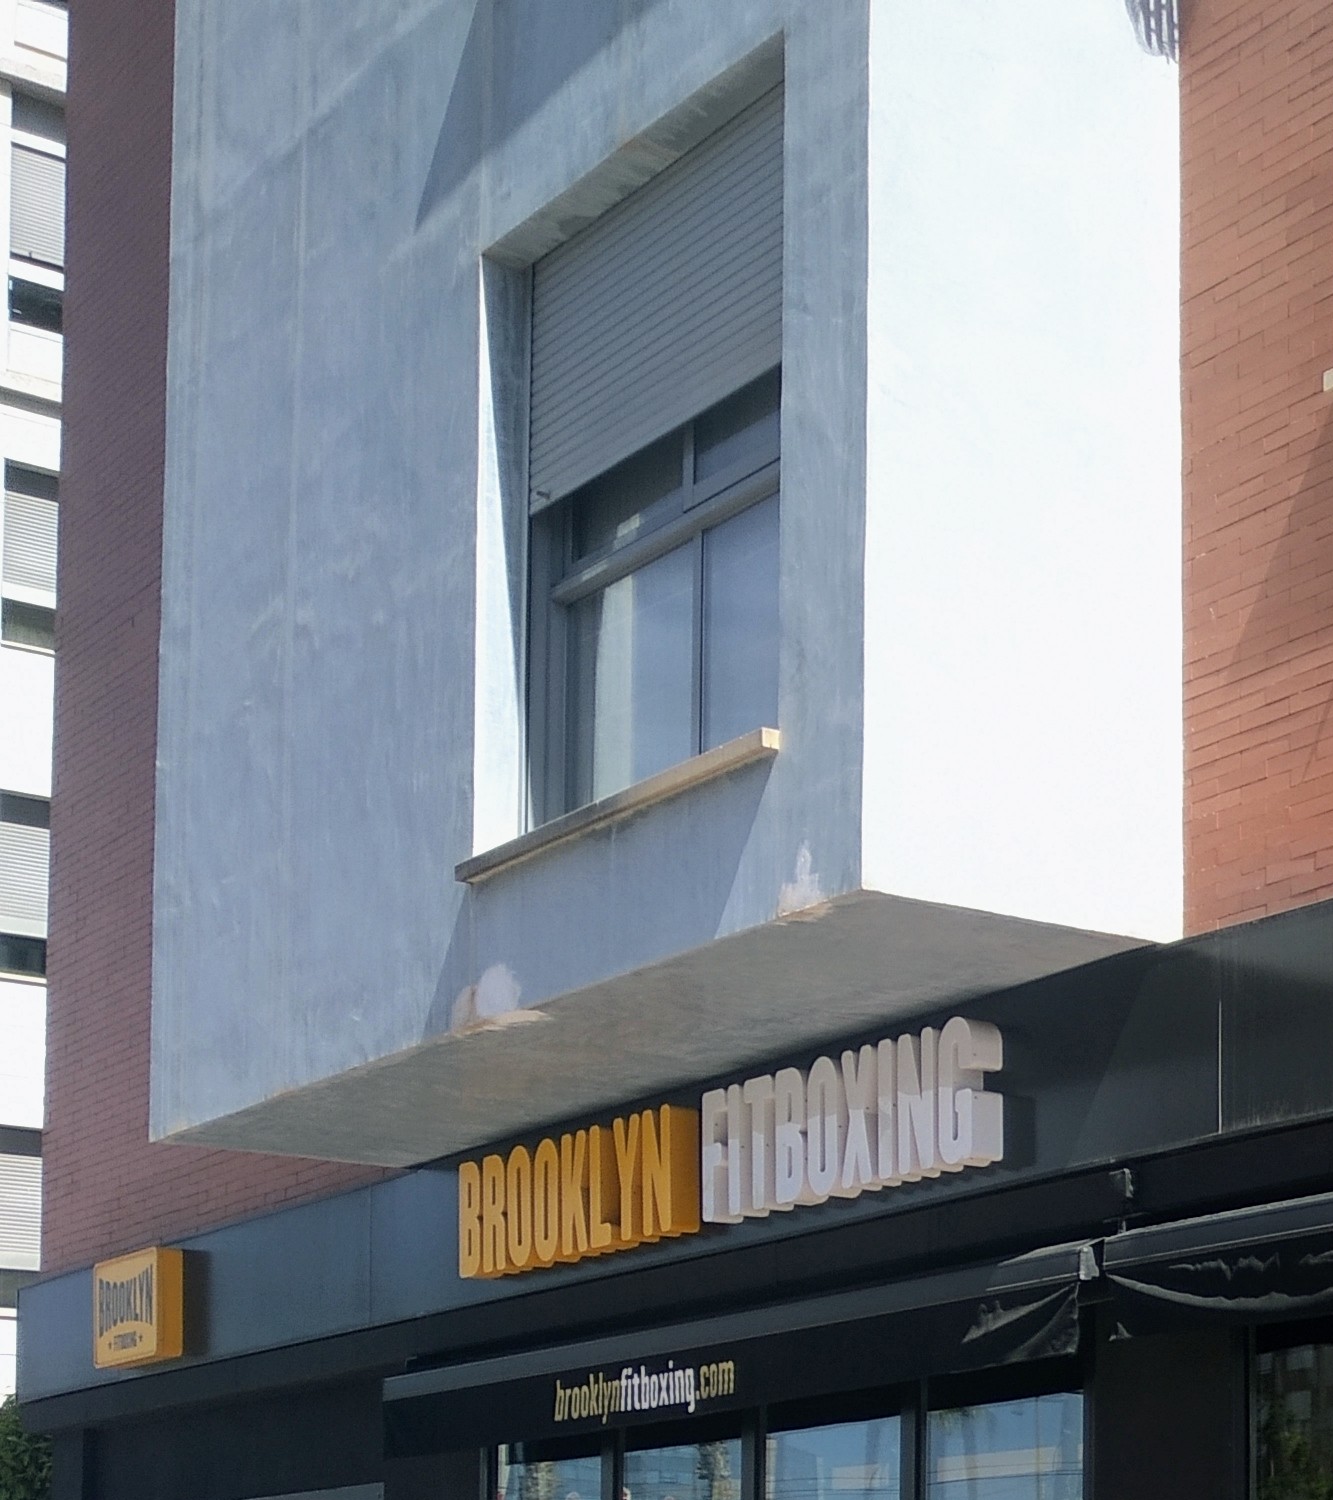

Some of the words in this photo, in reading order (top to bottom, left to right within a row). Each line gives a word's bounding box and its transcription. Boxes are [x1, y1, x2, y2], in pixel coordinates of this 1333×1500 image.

[458, 1102, 699, 1279] BROOKLYN
[702, 1015, 1003, 1224] FITBOXING
[98, 1262, 154, 1338] BROOKLYN
[554, 1359, 736, 1425] brooklynfitboxing.com
